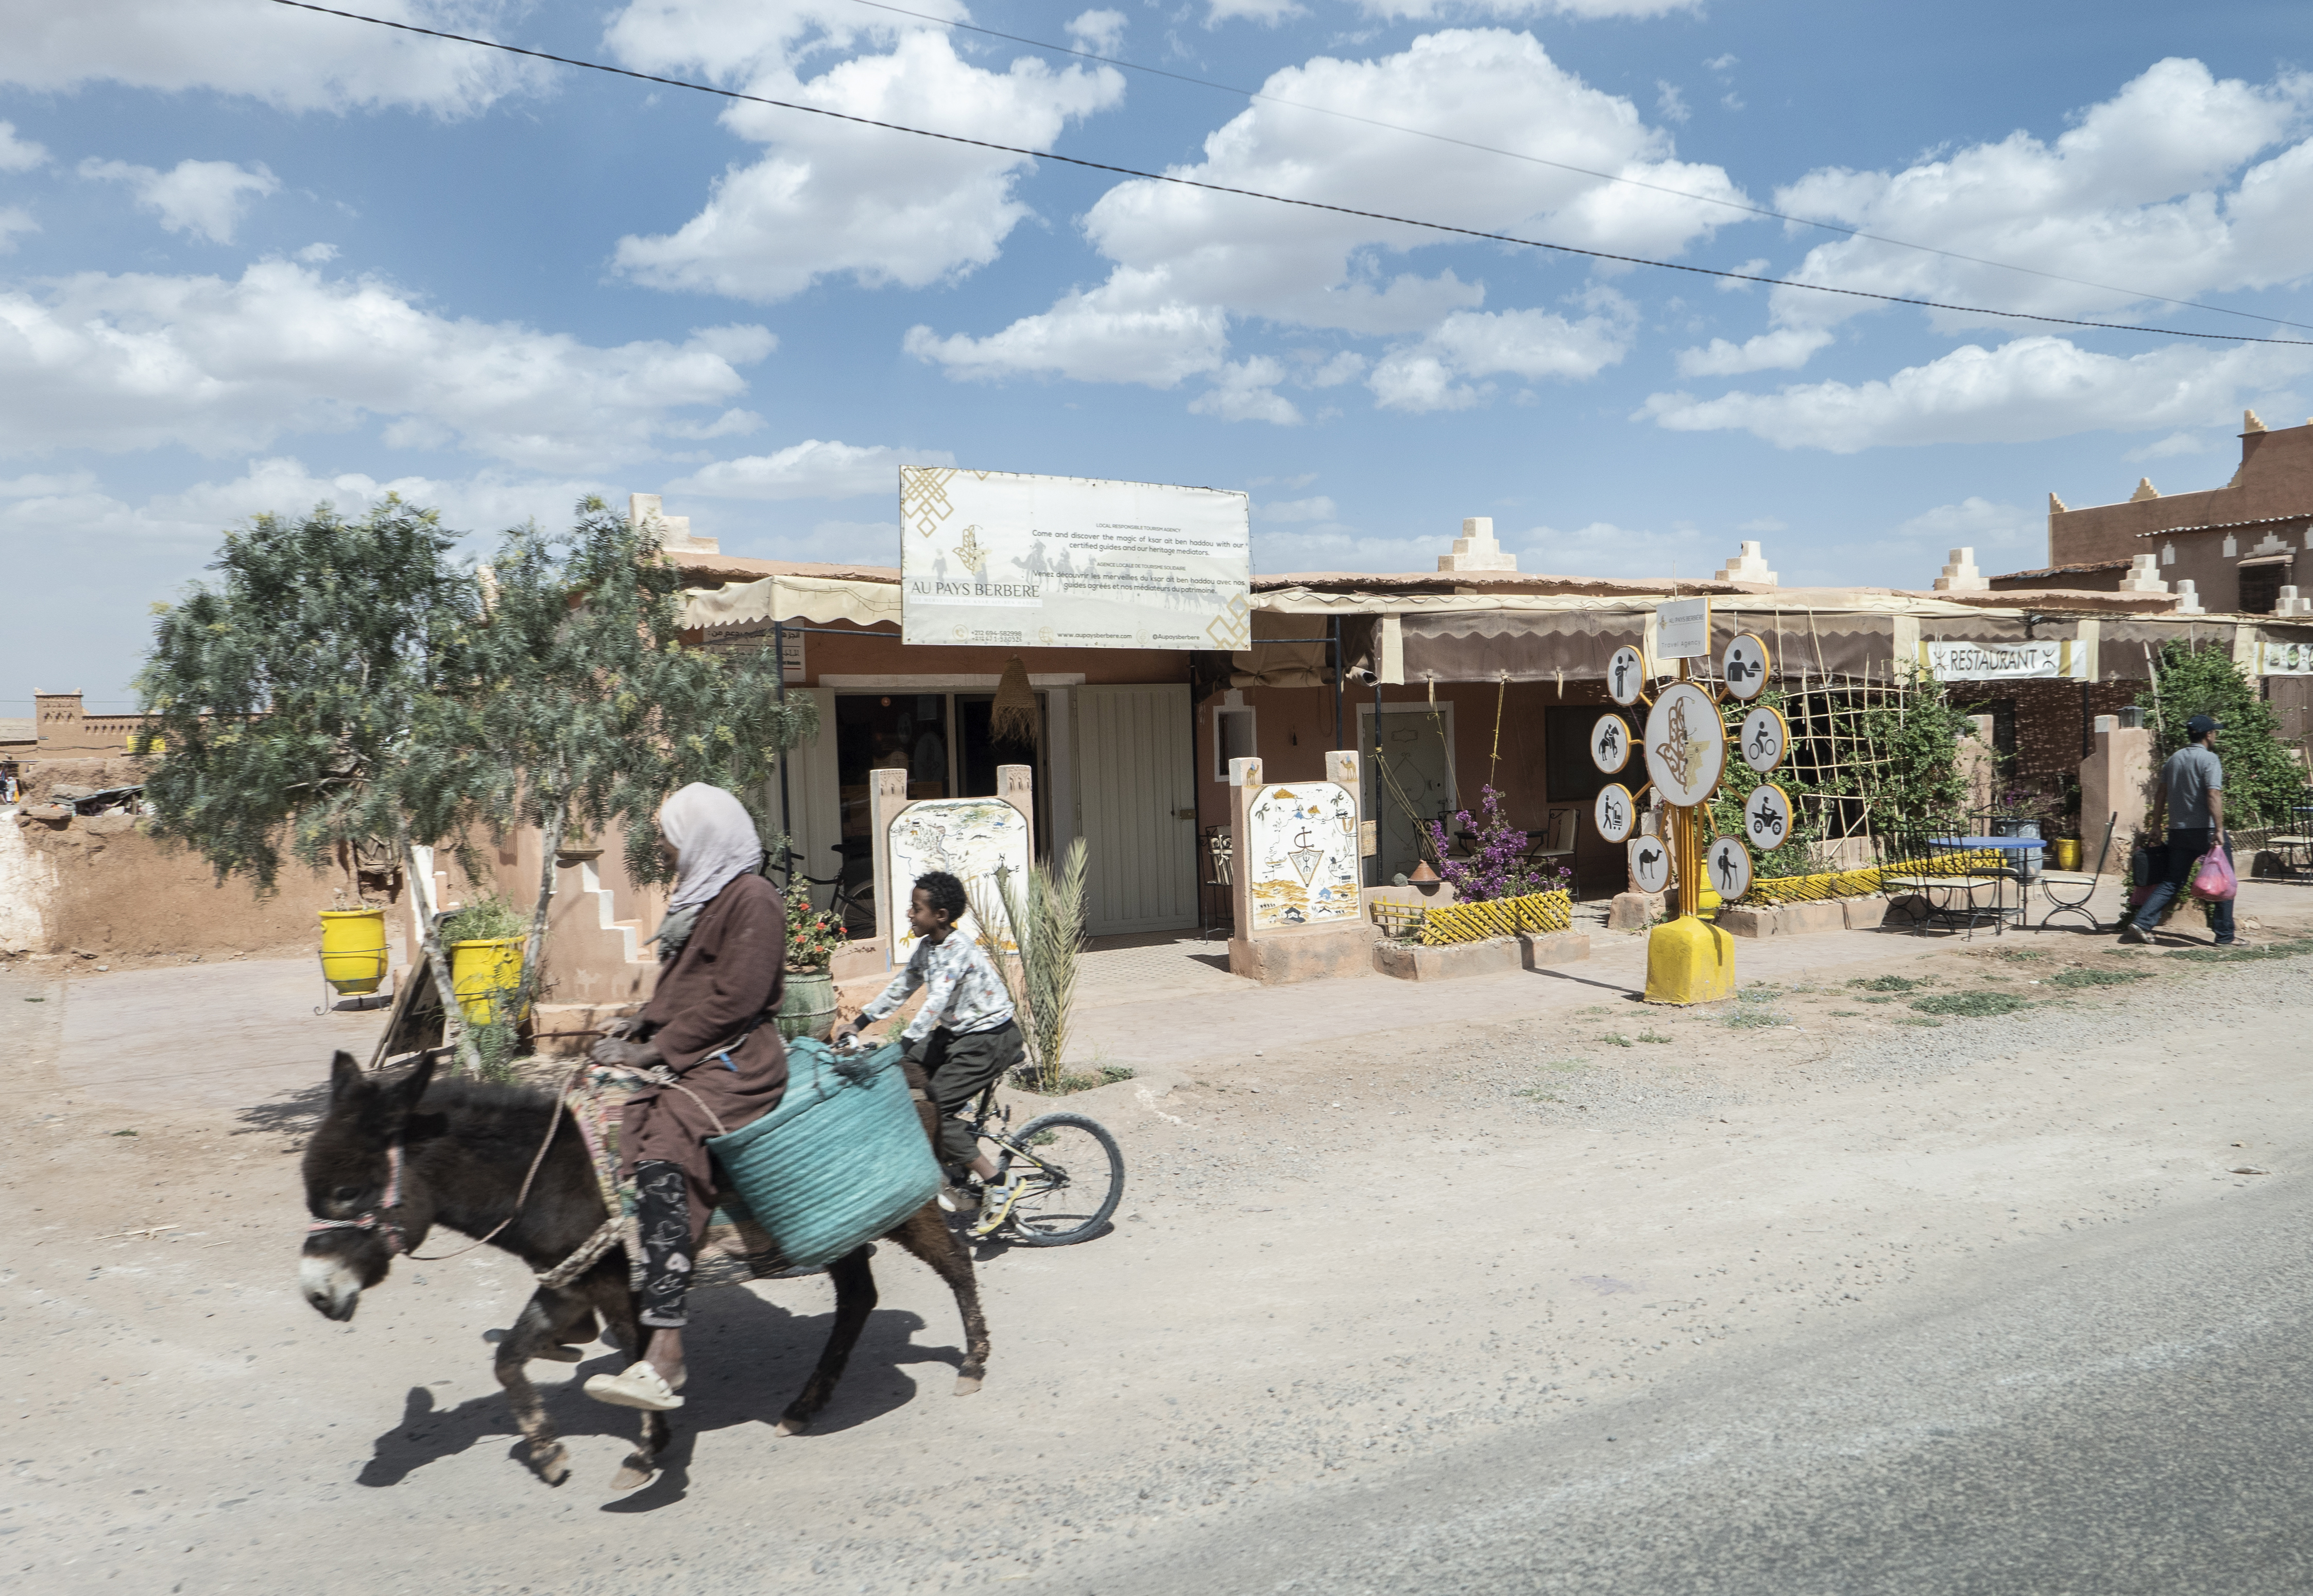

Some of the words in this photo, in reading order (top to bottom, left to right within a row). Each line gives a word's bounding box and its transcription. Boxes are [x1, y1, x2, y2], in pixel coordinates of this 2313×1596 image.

[1149, 546, 1175, 555] heritage
[911, 581, 931, 594] AU
[936, 582, 970, 595] PAYS
[975, 584, 1040, 597] BERBERE
[1950, 649, 2037, 671] RESTAURANT
